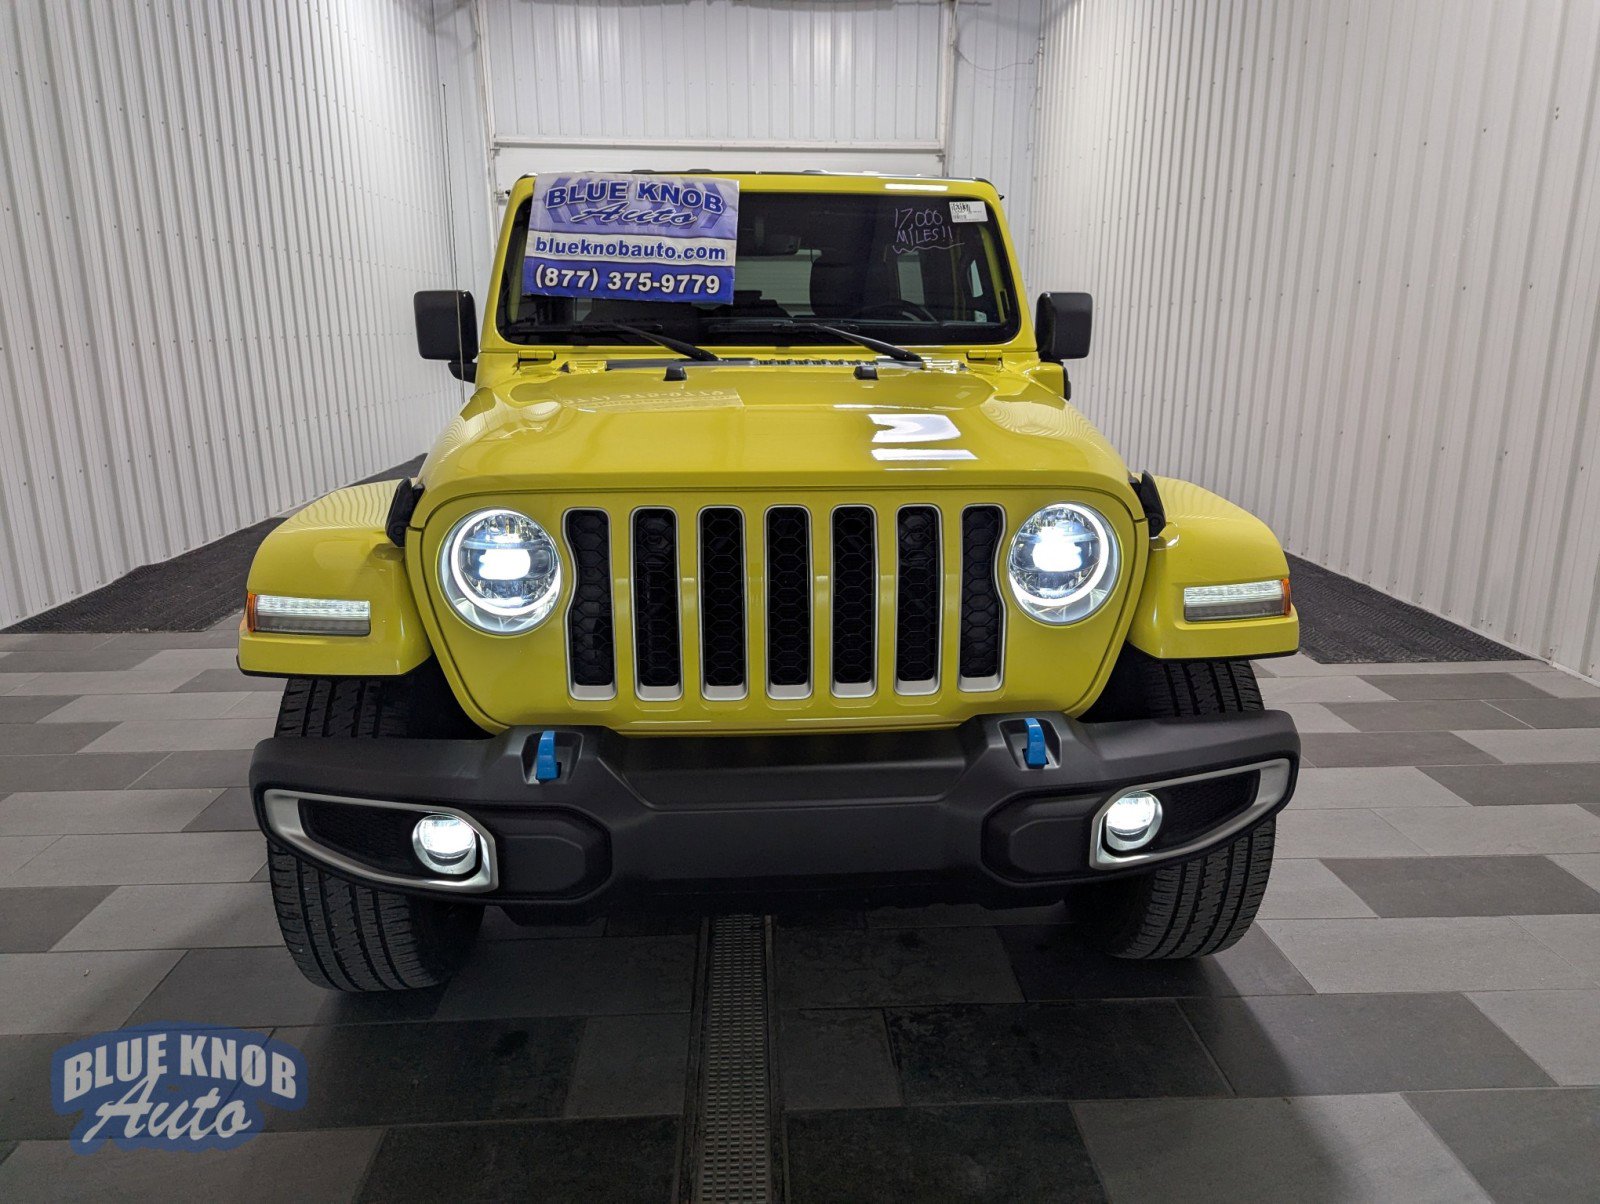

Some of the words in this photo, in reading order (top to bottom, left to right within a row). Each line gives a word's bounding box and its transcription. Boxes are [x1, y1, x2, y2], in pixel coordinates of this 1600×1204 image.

[547, 181, 628, 208] BLUE
[637, 180, 724, 214] KNOB
[570, 201, 697, 225] Auto
[535, 236, 726, 261] blueknobauto.com
[535, 264, 599, 291] (877)
[607, 271, 721, 294] 375-9779
